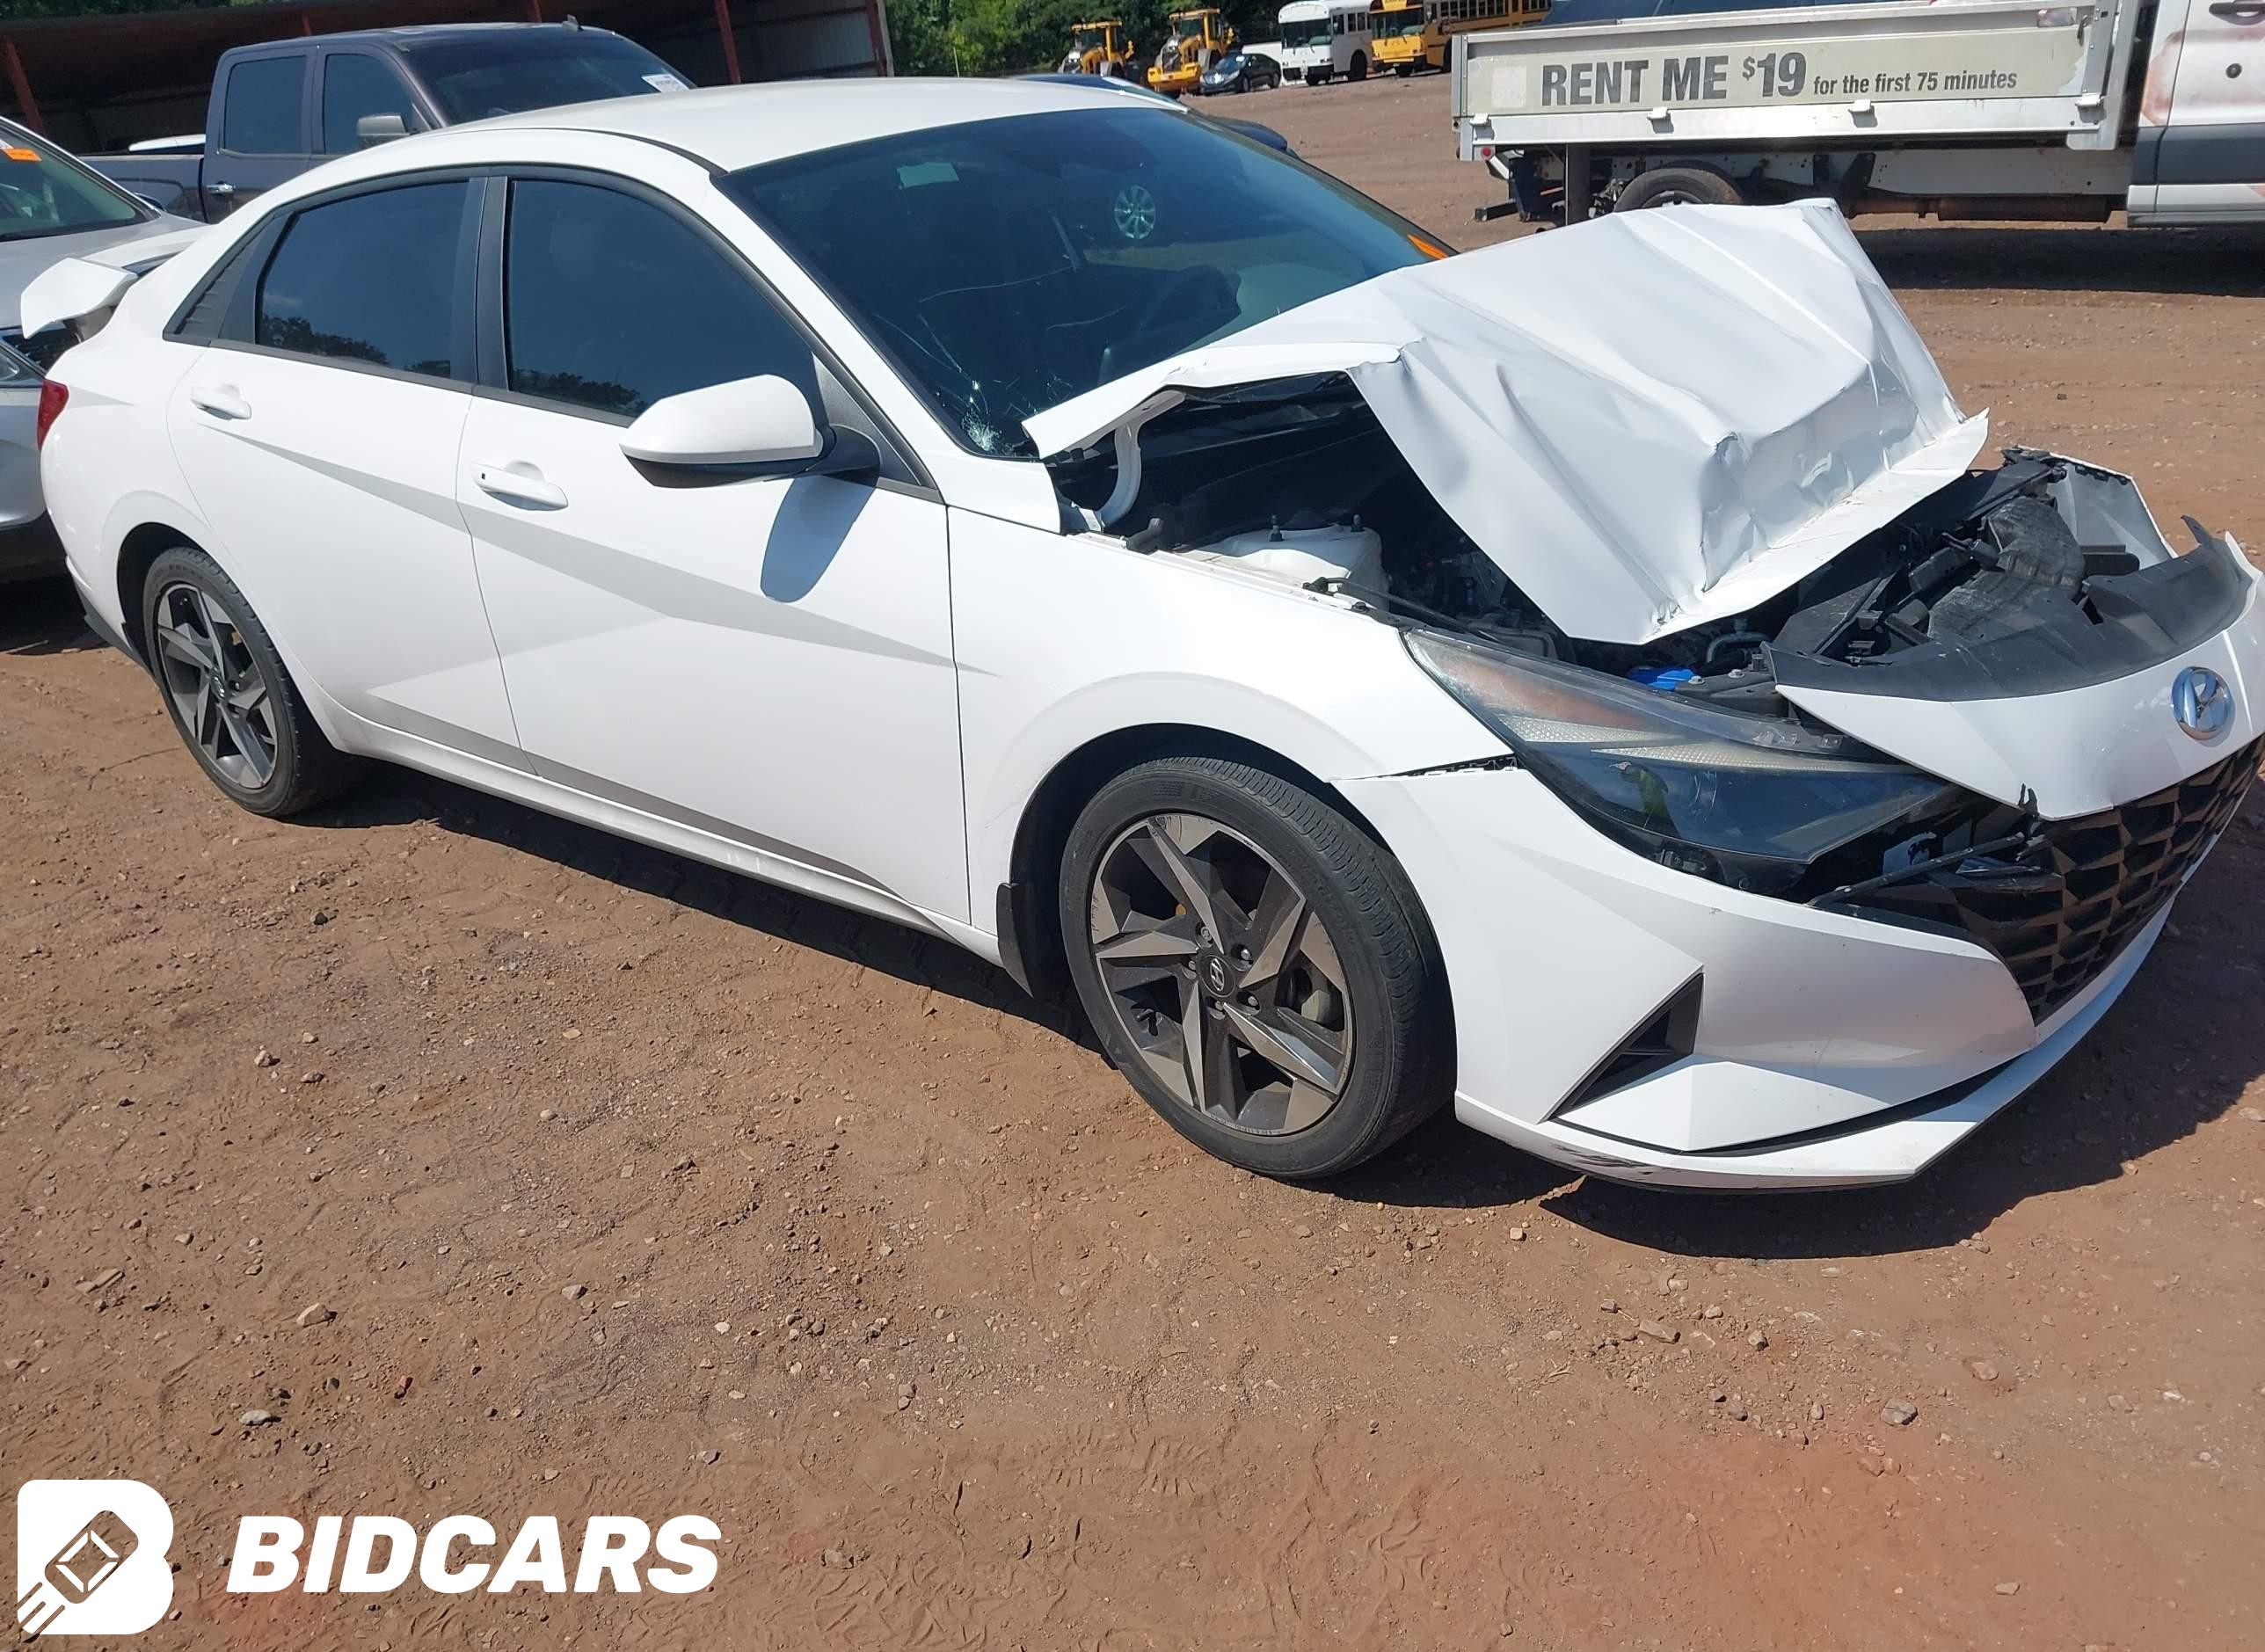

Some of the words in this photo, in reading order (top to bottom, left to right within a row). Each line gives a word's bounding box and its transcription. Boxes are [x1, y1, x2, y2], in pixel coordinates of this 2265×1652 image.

[1541, 59, 1650, 106] RENT
[1662, 55, 1730, 102] ME
[1742, 51, 1807, 98] $19
[1814, 76, 1838, 95] for
[1842, 75, 1869, 93] the
[1875, 73, 1911, 92] first
[1917, 71, 1939, 91] 75
[1944, 69, 2017, 90] minutes
